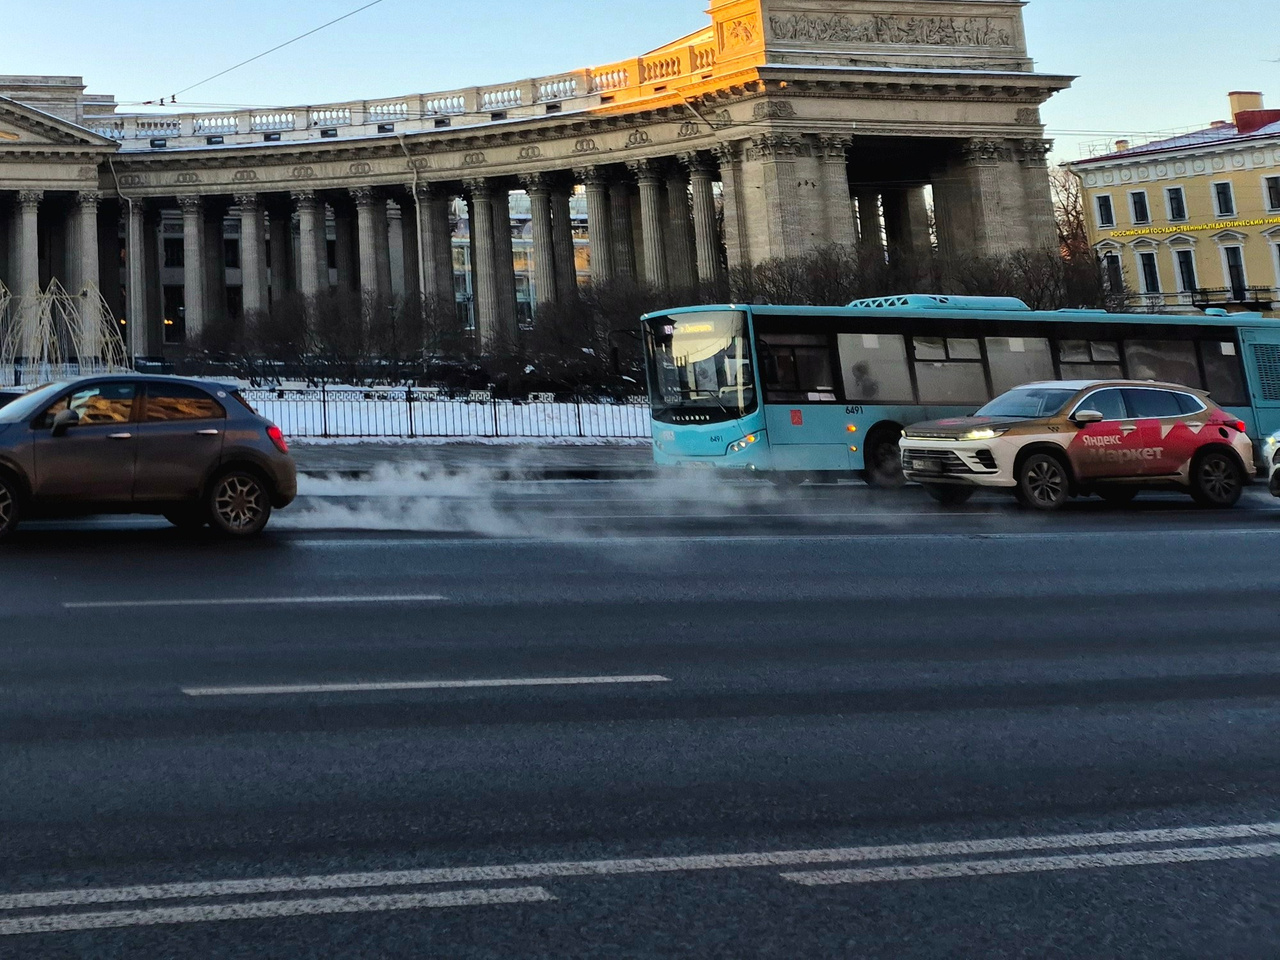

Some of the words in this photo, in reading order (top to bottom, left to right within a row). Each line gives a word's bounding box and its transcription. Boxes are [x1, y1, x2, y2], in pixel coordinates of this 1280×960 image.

[1110, 228, 1150, 237] РОССИЙСКИЙ
[1151, 222, 1208, 234] ГОСУДАРСТВЕННЫЙ
[1208, 218, 1264, 230] ПЕДАГОГИЧЕСКИЙ
[845, 406, 864, 415] 6491
[1082, 435, 1122, 446] Яндекс
[1088, 447, 1164, 463] Маркет
